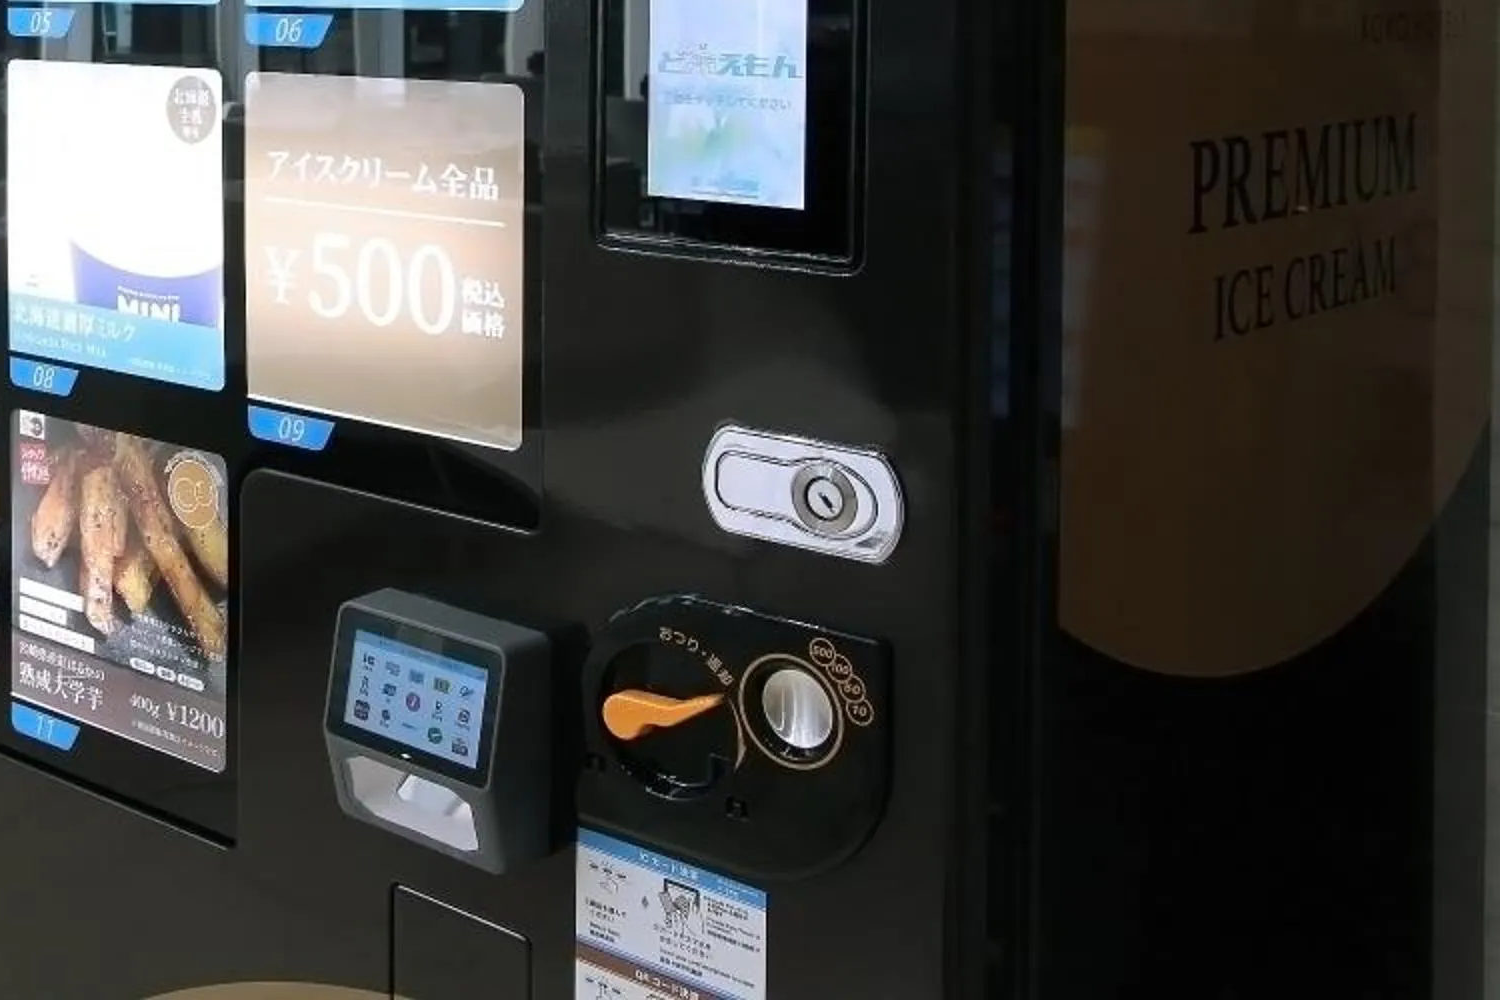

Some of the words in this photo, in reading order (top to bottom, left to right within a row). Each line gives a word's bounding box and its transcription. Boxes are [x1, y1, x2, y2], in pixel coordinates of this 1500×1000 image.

[30, 10, 53, 34] 05
[275, 14, 304, 42] 06
[267, 150, 499, 201] アイスクリーム全品
[1188, 111, 1418, 234] PREMIUM
[461, 276, 506, 309] 税込
[1213, 264, 1275, 343] ICE
[1284, 234, 1396, 320] CREAM
[461, 310, 506, 340] 価格
[32, 363, 55, 389] 08
[277, 415, 306, 442] 09
[812, 644, 834, 660] 500
[18, 660, 104, 711] 熟成大学芋
[35, 714, 55, 741] 11
[130, 692, 161, 720] 400g
[165, 700, 225, 739] ¥1200
